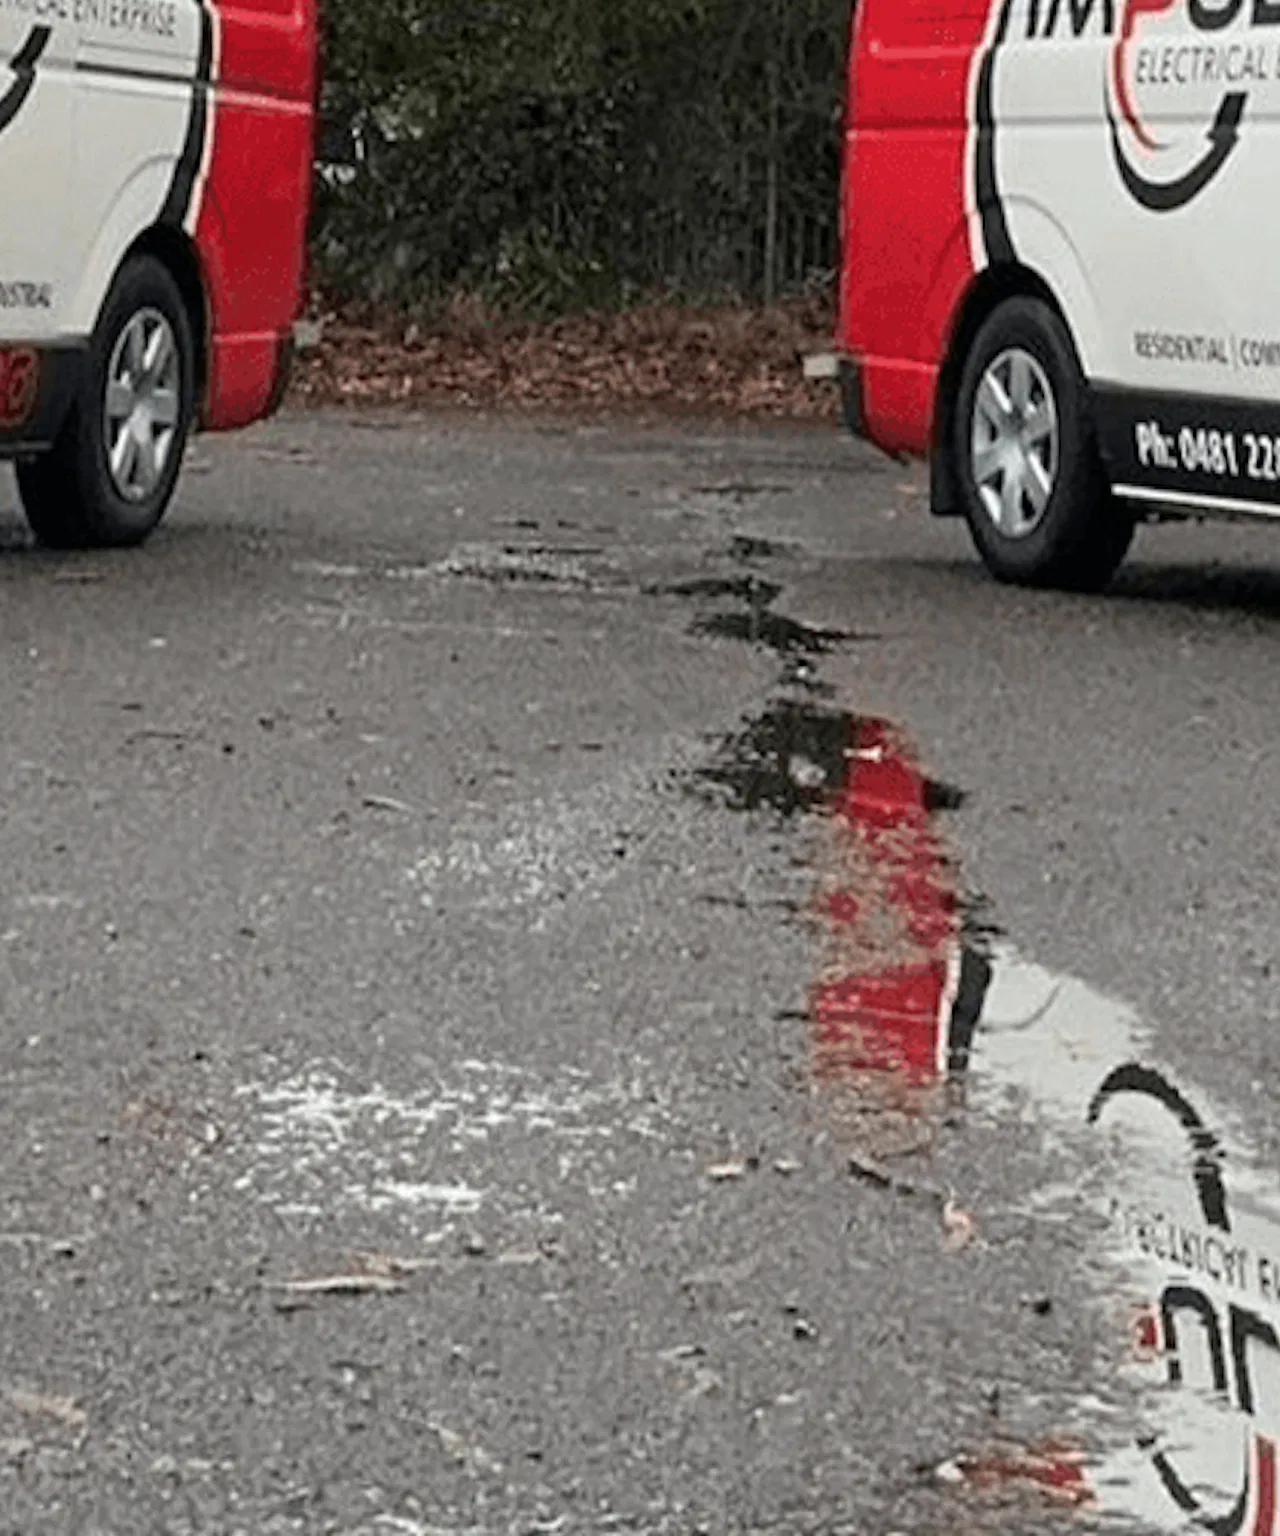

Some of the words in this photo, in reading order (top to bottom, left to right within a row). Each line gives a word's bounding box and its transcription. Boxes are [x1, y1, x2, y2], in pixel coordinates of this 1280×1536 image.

[1135, 47, 1267, 85] ELECTRICAL
[1135, 420, 1178, 469] Ph:
[1179, 425, 1239, 477] 0481
